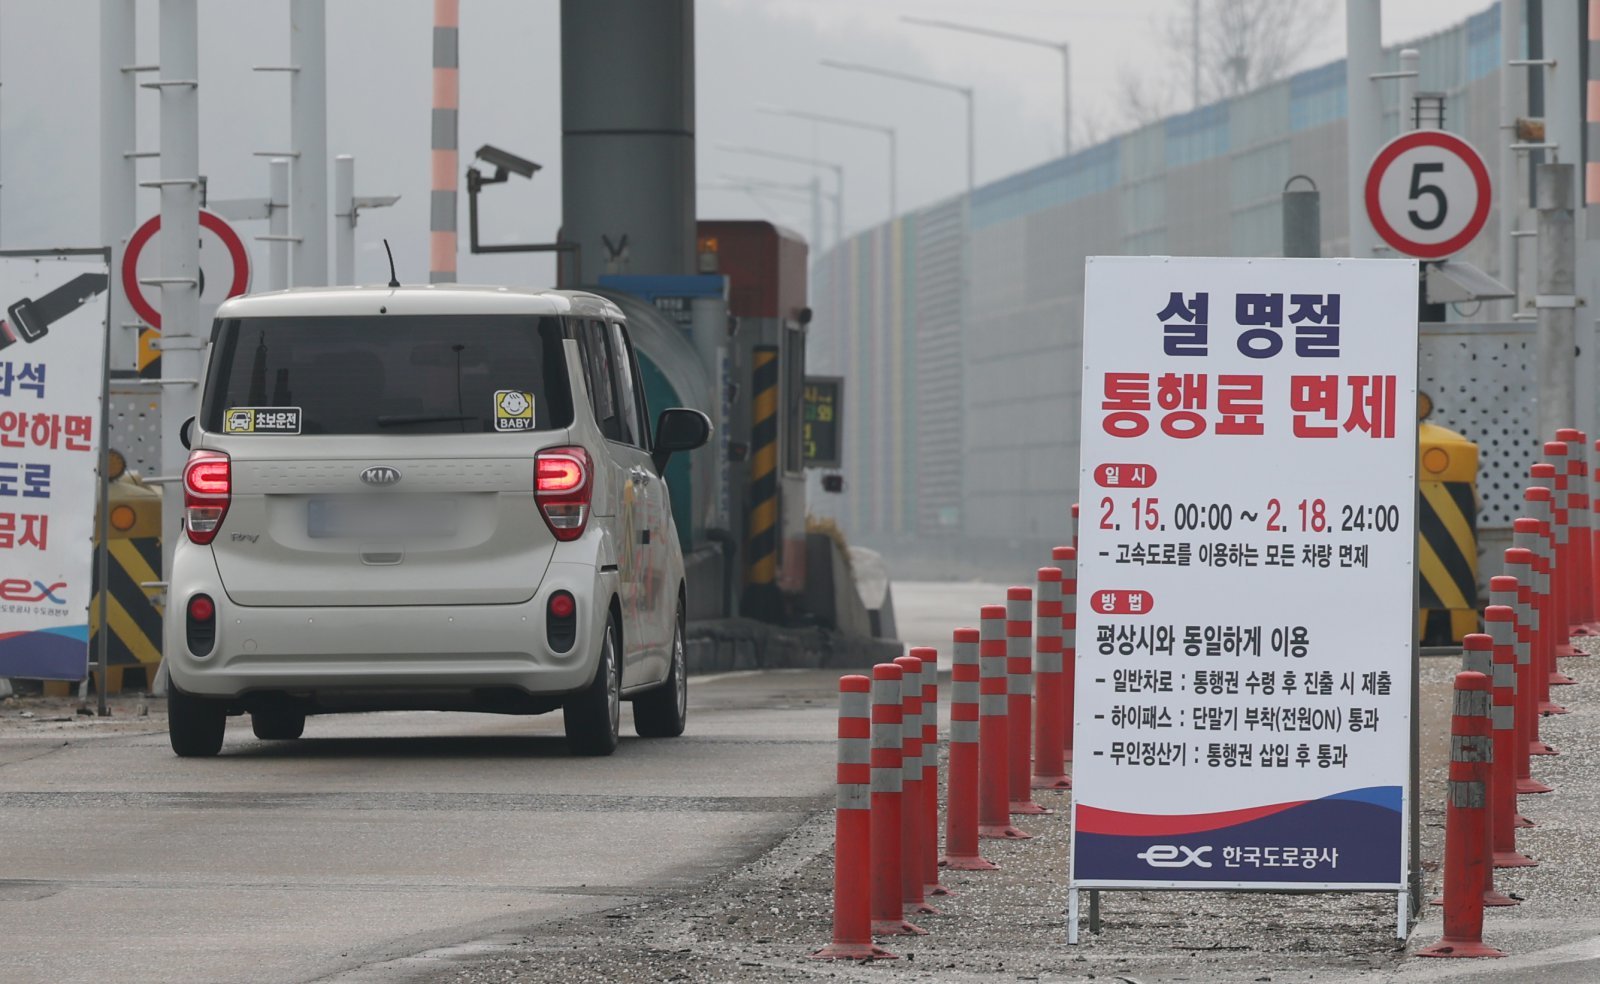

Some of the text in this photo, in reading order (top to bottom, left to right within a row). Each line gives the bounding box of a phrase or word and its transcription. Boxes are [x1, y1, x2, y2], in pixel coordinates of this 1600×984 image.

[1408, 163, 1448, 230] 5
[1156, 292, 1340, 359] 설 명절
[1102, 372, 1396, 439] 통행료 면제
[0, 411, 92, 451] 안하면
[254, 413, 296, 428] 초보운전
[498, 417, 532, 430] BABY
[367, 470, 394, 482] KIA
[1100, 497, 1120, 531] 2.
[1132, 498, 1165, 531] 15.
[1175, 503, 1232, 530] 00:00
[1267, 499, 1287, 532] 2.
[1299, 499, 1332, 533] 18.
[1342, 505, 1399, 532] 24:00
[1116, 542, 1192, 566] 고속도로를
[1199, 543, 1259, 567] 이용하는
[1265, 544, 1295, 567] 모든
[1302, 544, 1332, 568] 차량
[1339, 544, 1368, 568] 면제
[0, 579, 67, 604] ex
[0, 605, 30, 614] 도로공사
[1097, 624, 1309, 658] 평상시와 동일하게 이용
[1113, 669, 1173, 693] 일반차로
[1193, 671, 1238, 695] 통행권
[1245, 671, 1275, 695] 수령
[1282, 671, 1297, 695] 후
[1304, 671, 1333, 695] 진출
[1340, 672, 1354, 695] 시
[1362, 671, 1391, 695] 제출
[1112, 705, 1172, 729] 하이패스
[1193, 707, 1237, 731] 단말기
[1244, 706, 1341, 733] 부착(전원ON)
[1348, 708, 1379, 732] 통과
[1110, 741, 1186, 766] 무인정산기
[1207, 743, 1252, 767] 통행권
[1259, 744, 1288, 767] 삽입
[1296, 744, 1310, 768] 후
[1317, 744, 1348, 768] 통과
[1137, 845, 1338, 869] ex 한국도로공사
